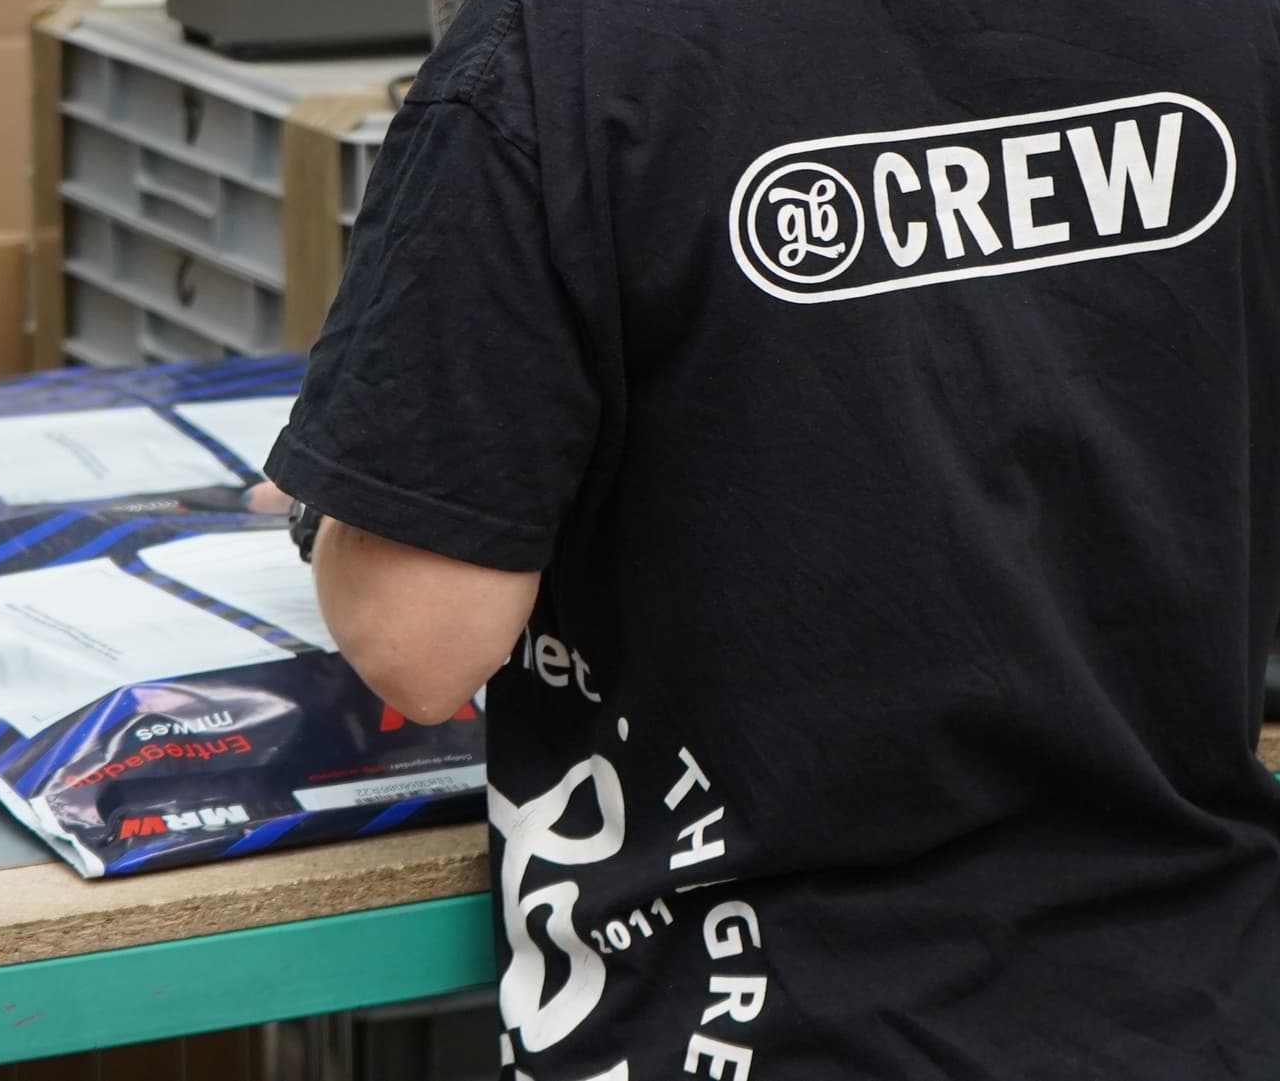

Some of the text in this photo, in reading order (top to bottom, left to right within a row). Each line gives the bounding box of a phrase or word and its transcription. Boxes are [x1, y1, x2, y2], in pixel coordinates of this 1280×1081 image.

[873, 112, 1183, 268] CREW
[135, 711, 233, 741] mrw.es
[120, 805, 250, 839] MRW
[591, 898, 673, 954] 2011
